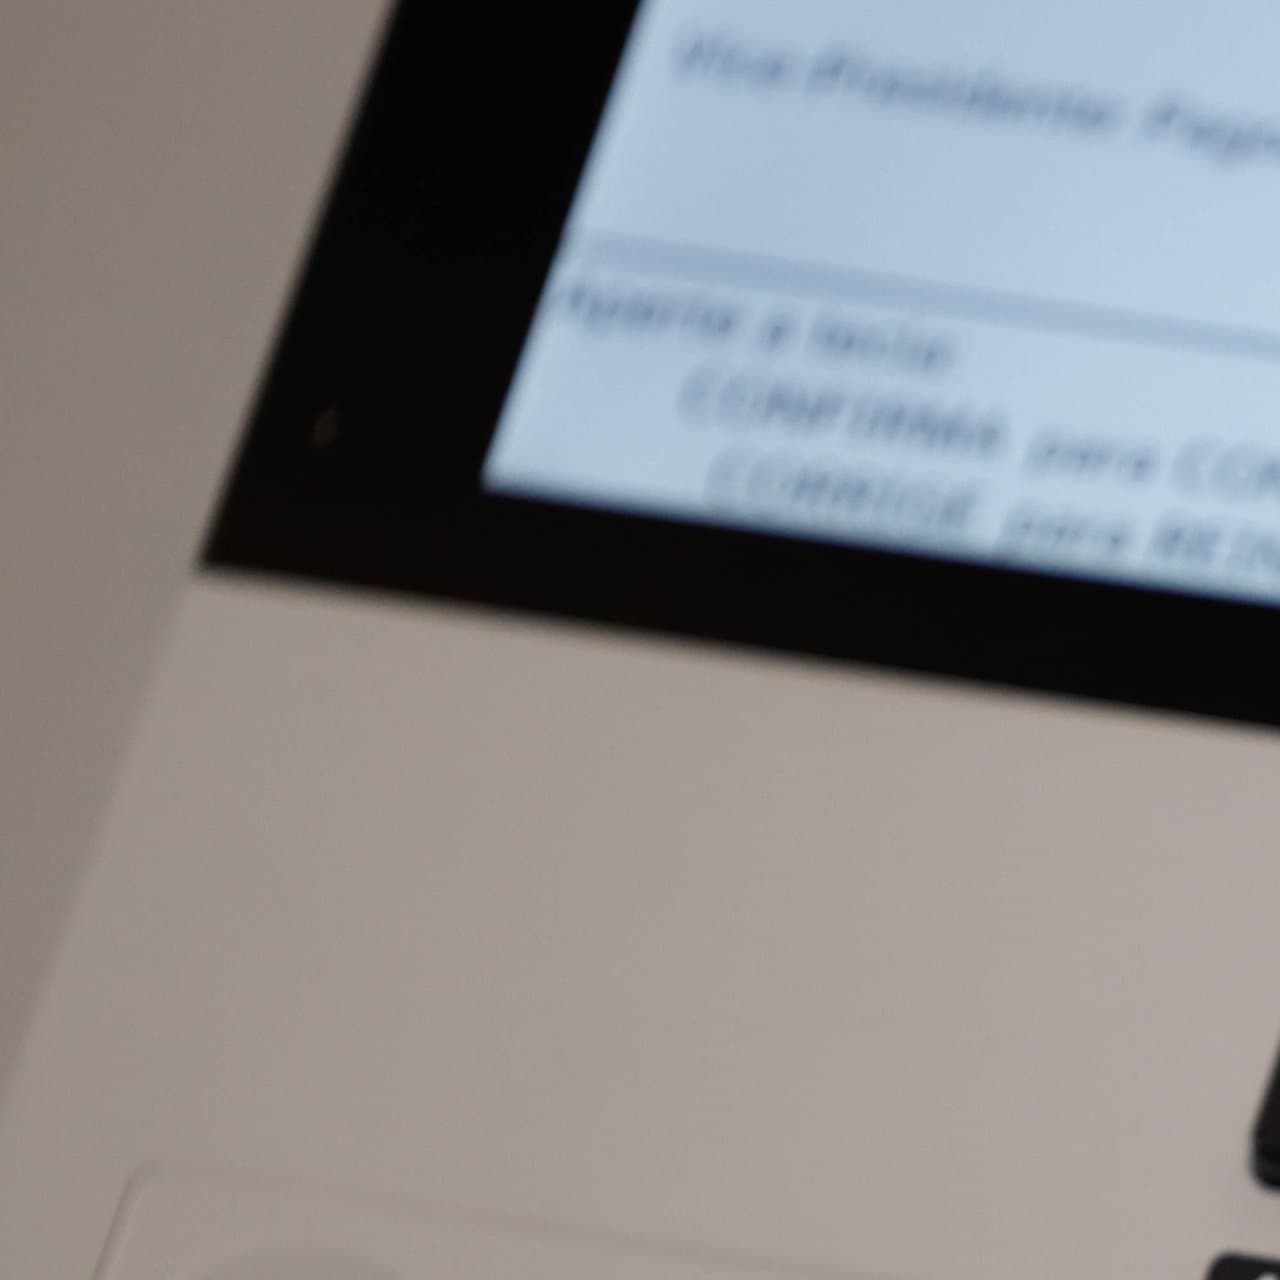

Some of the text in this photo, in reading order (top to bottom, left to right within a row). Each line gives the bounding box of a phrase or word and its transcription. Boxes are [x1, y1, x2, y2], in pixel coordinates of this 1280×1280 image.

[677, 361, 1011, 459] CONFIRMA
[1026, 426, 1161, 486] para
[1002, 502, 1137, 562] para
